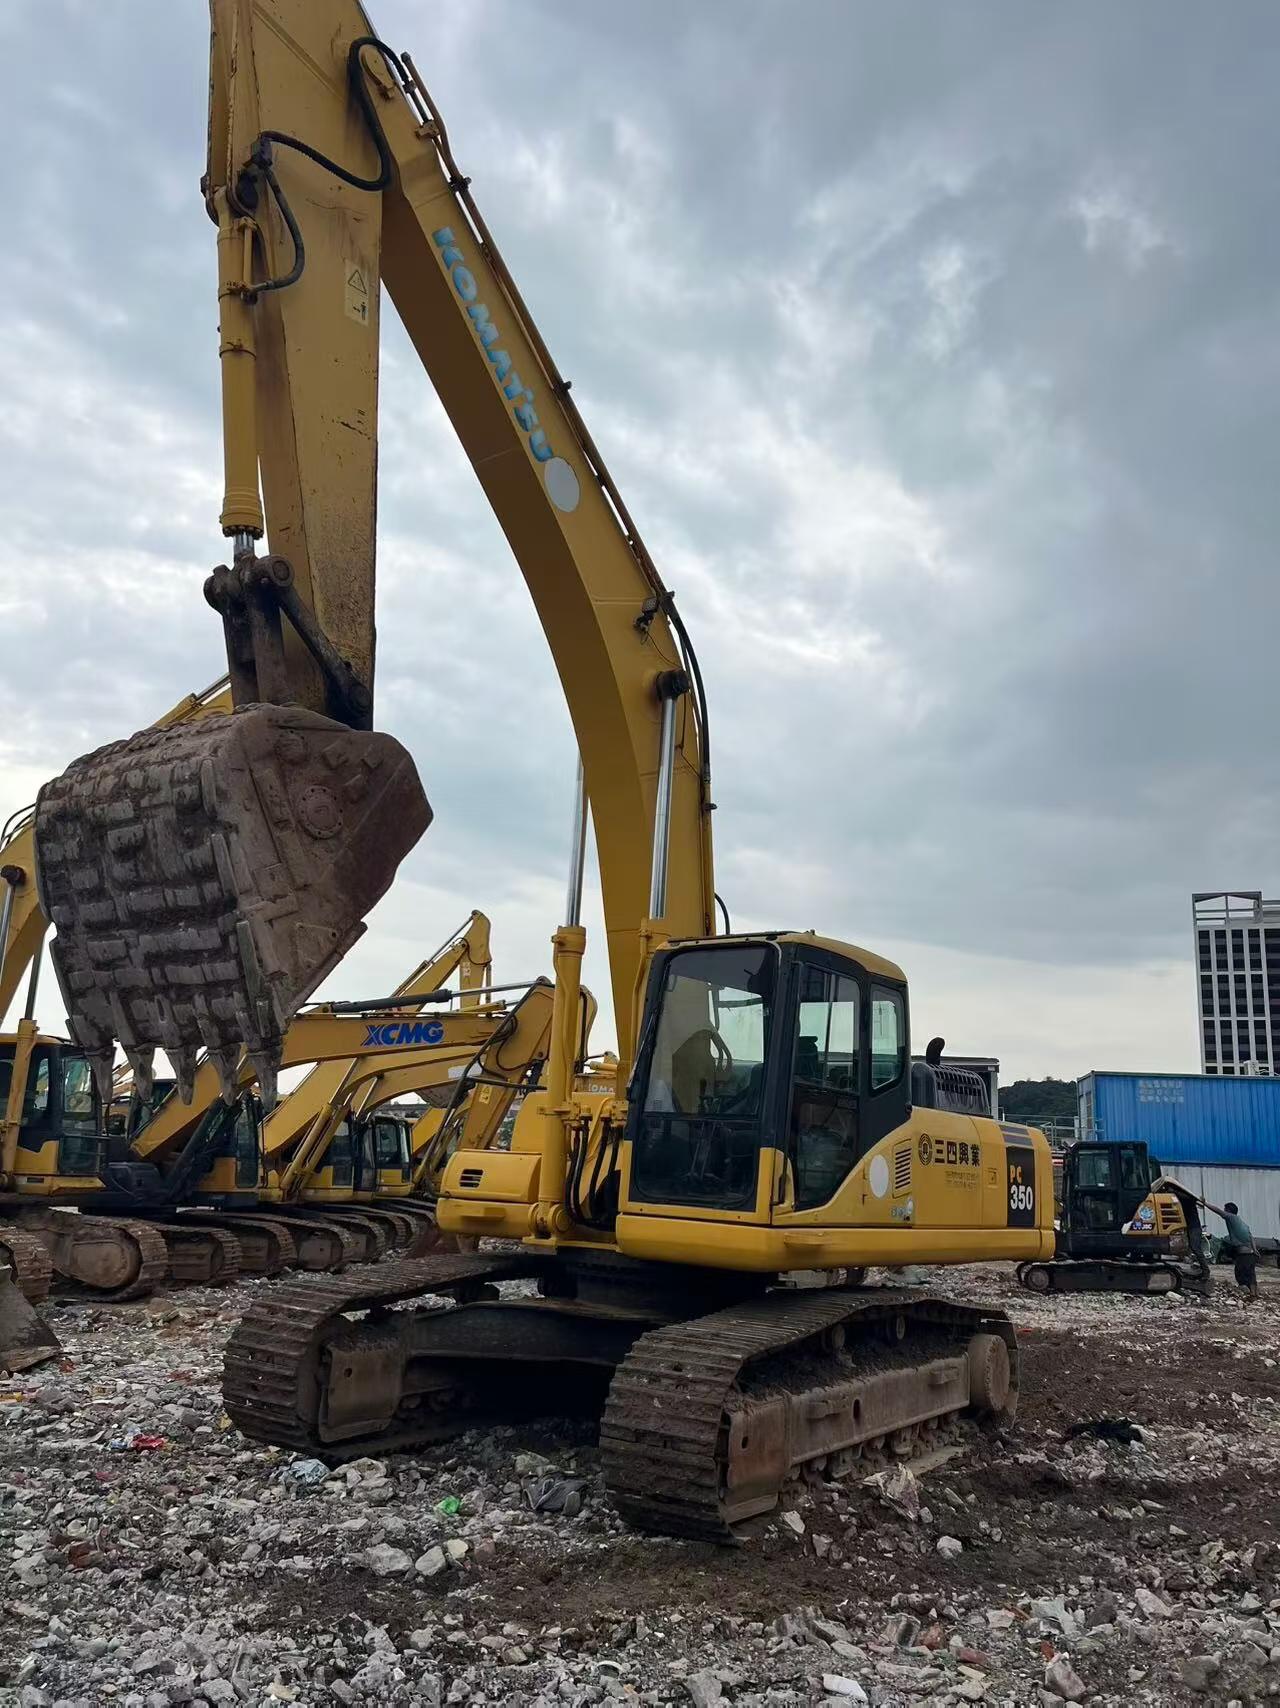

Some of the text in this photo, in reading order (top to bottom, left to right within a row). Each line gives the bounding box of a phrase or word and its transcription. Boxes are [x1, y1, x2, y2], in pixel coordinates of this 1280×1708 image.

[432, 226, 553, 462] KOMATSU
[360, 1020, 445, 1047] XCMG
[934, 1139, 980, 1167] 三四興業
[1009, 1165, 1023, 1184] PC
[1010, 1184, 1034, 1211] 350
